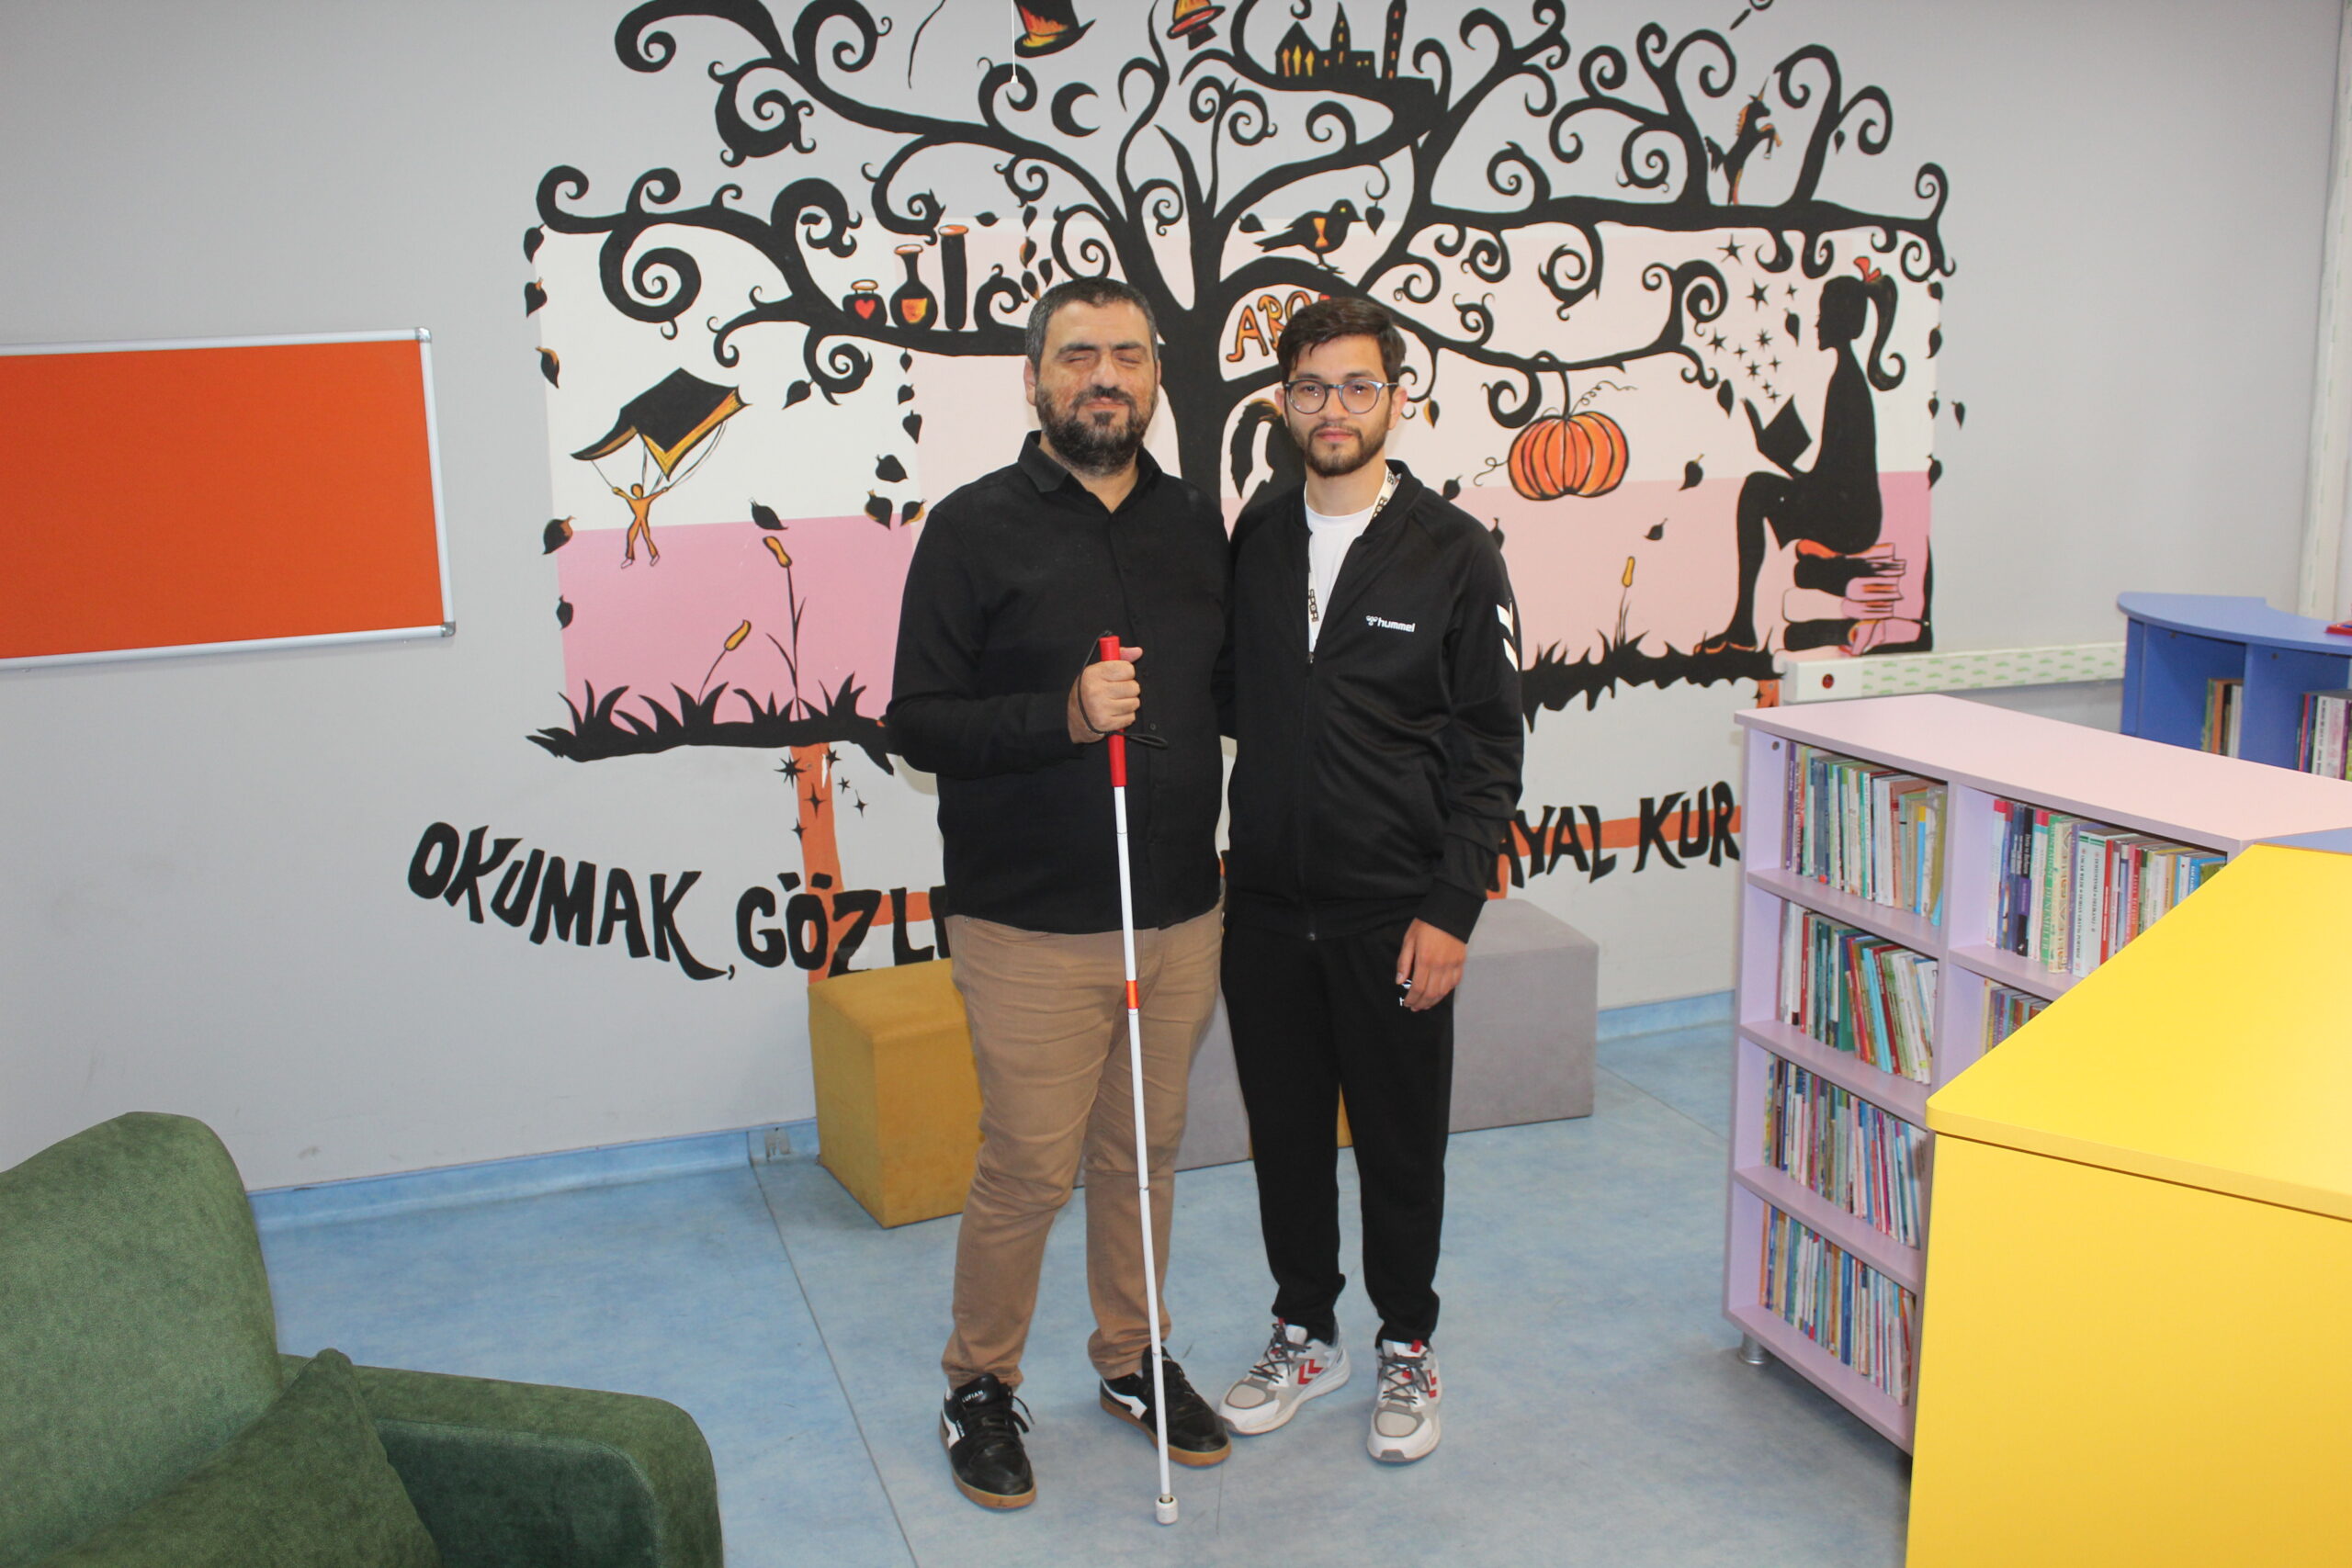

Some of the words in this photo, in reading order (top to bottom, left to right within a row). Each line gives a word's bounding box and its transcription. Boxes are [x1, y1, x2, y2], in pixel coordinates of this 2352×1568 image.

[1377, 616, 1416, 632] hummel
[408, 821, 735, 981] OKUMAK,
[1486, 805, 1617, 892] AYAL
[1632, 781, 1741, 874] KUR
